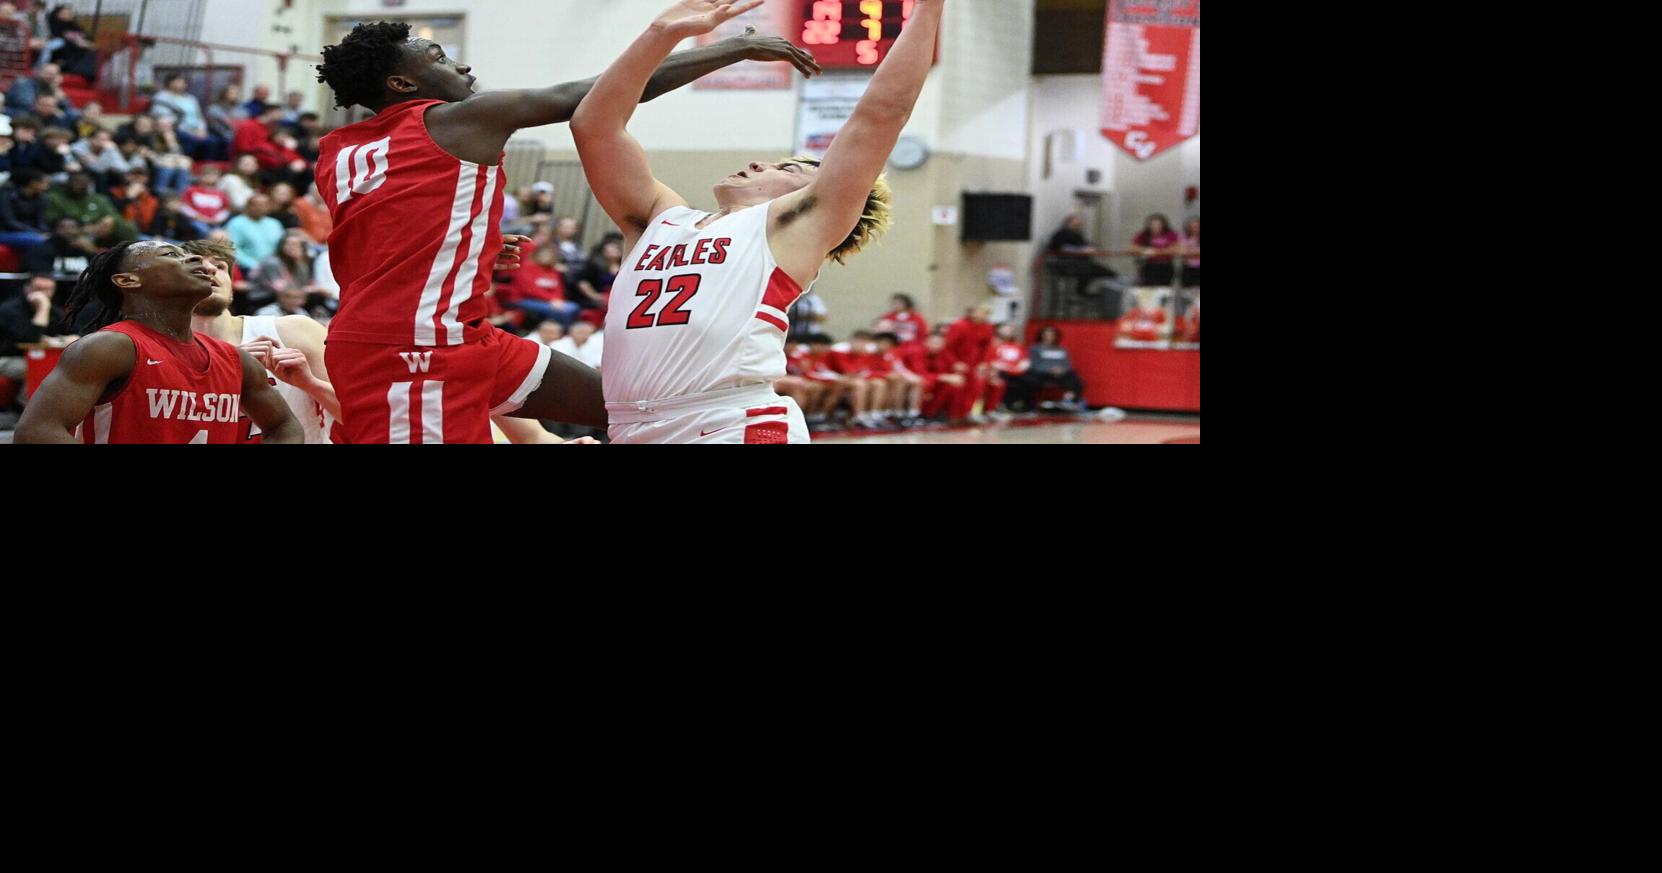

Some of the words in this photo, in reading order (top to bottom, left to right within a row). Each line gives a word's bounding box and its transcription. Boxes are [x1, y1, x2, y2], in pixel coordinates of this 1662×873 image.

[855, 40, 878, 64] 5
[335, 135, 391, 205] 10
[625, 273, 702, 329] 22
[398, 350, 433, 373] W
[145, 388, 241, 423] WILSON
